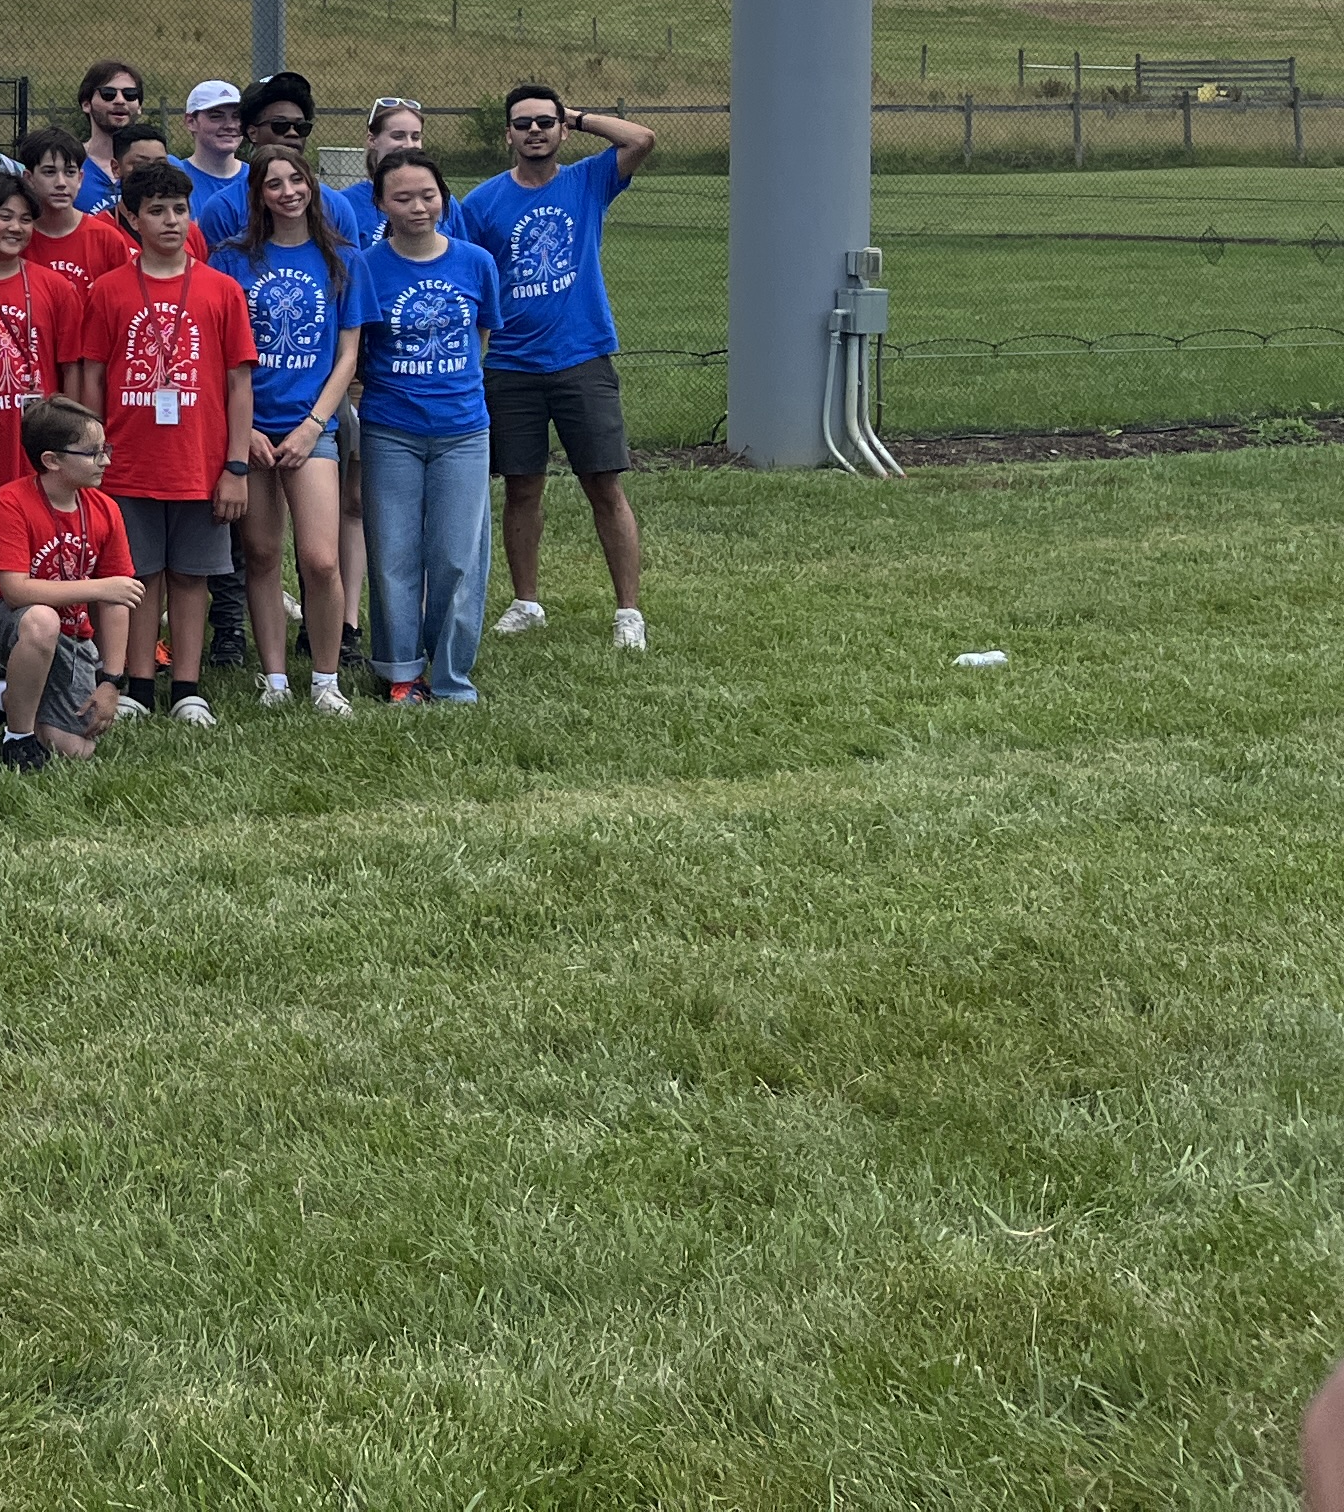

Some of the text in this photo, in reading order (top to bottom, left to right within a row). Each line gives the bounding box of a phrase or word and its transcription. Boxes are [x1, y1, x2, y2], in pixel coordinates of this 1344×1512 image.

[511, 206, 561, 262] VIRGINIA TECH
[50, 261, 83, 277] TECH
[248, 268, 326, 323] VIRGINIA TECH WING
[512, 282, 548, 298] DRONE
[1, 305, 26, 320] ECH
[391, 279, 471, 335] VIRGINIA TECH WING
[189, 325, 200, 360] WING
[259, 334, 311, 344] 20 25
[406, 344, 419, 352] 20
[258, 352, 317, 369] ONE CAMP
[392, 356, 467, 375] DRONE CAMP
[134, 373, 146, 381] 20
[180, 392, 197, 406] MP
